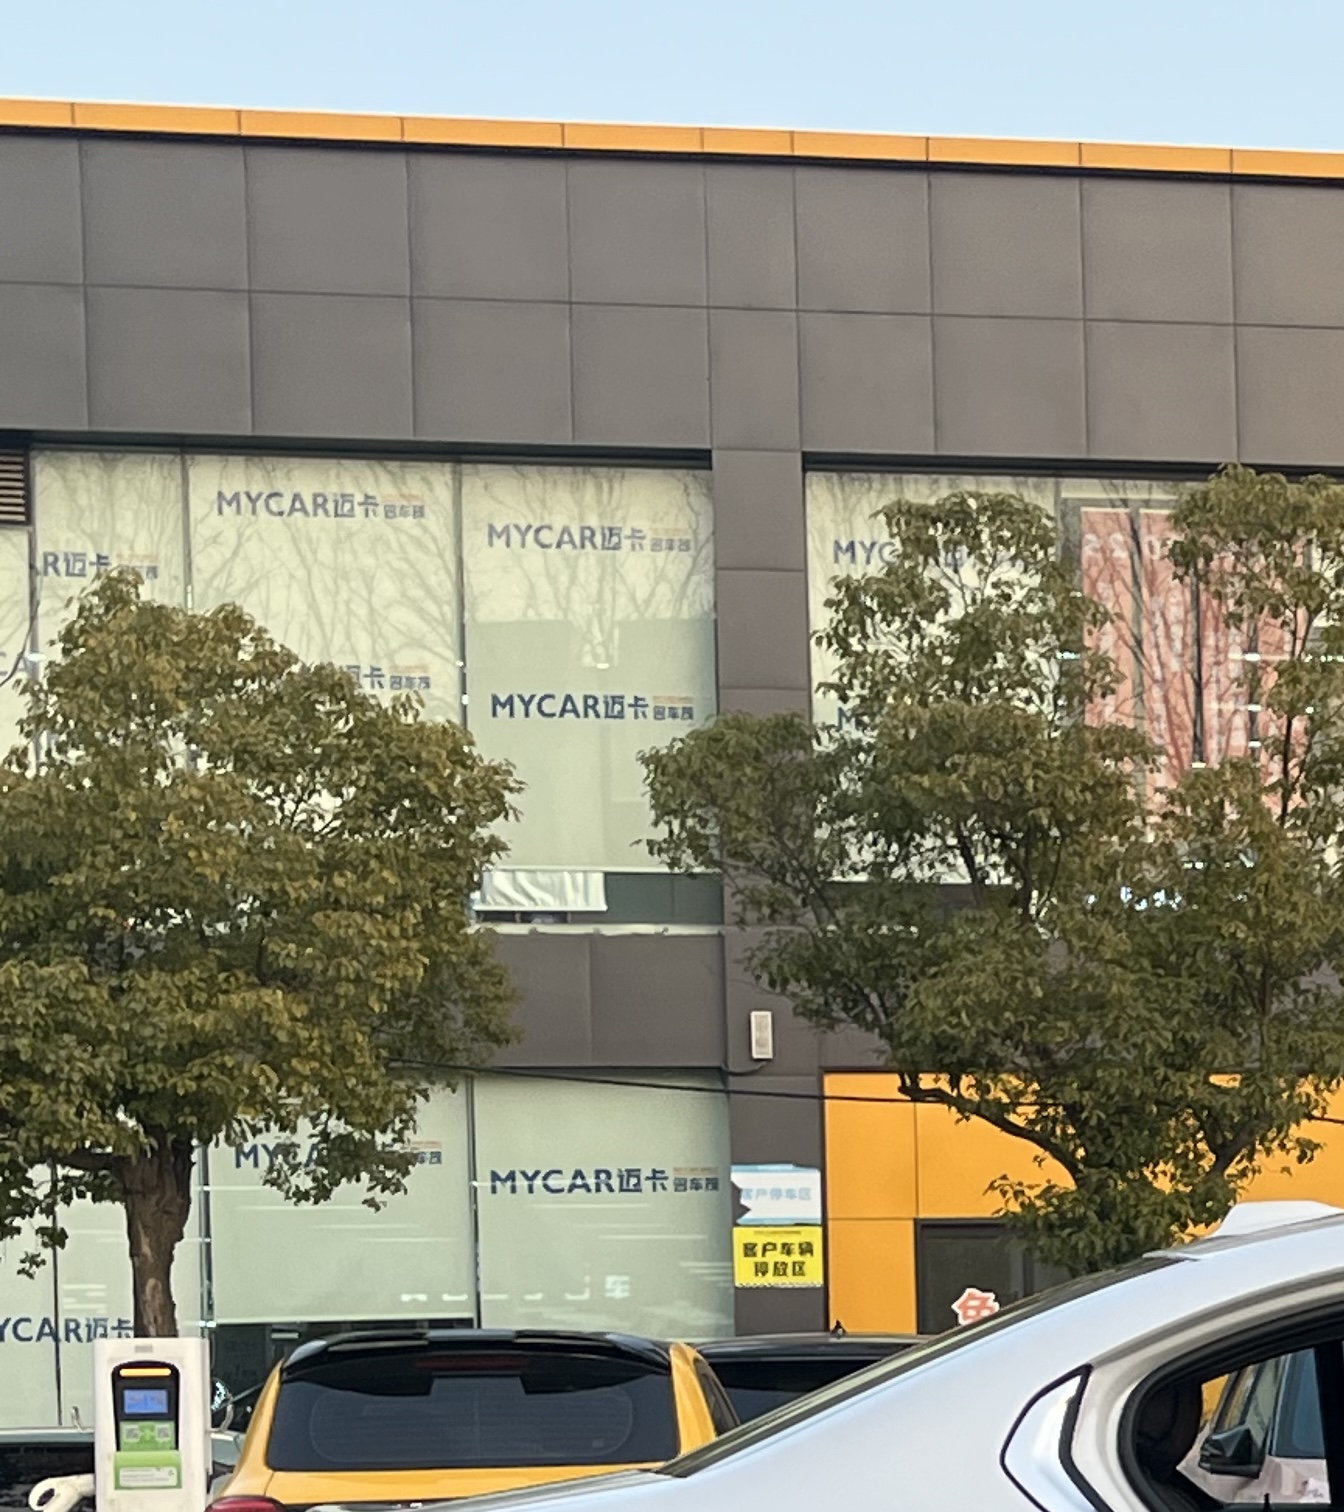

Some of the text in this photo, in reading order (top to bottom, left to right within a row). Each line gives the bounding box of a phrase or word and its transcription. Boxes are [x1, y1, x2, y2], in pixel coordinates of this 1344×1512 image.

[742, 1241, 815, 1258] 客户车辆
[754, 1260, 806, 1277] 停放区
